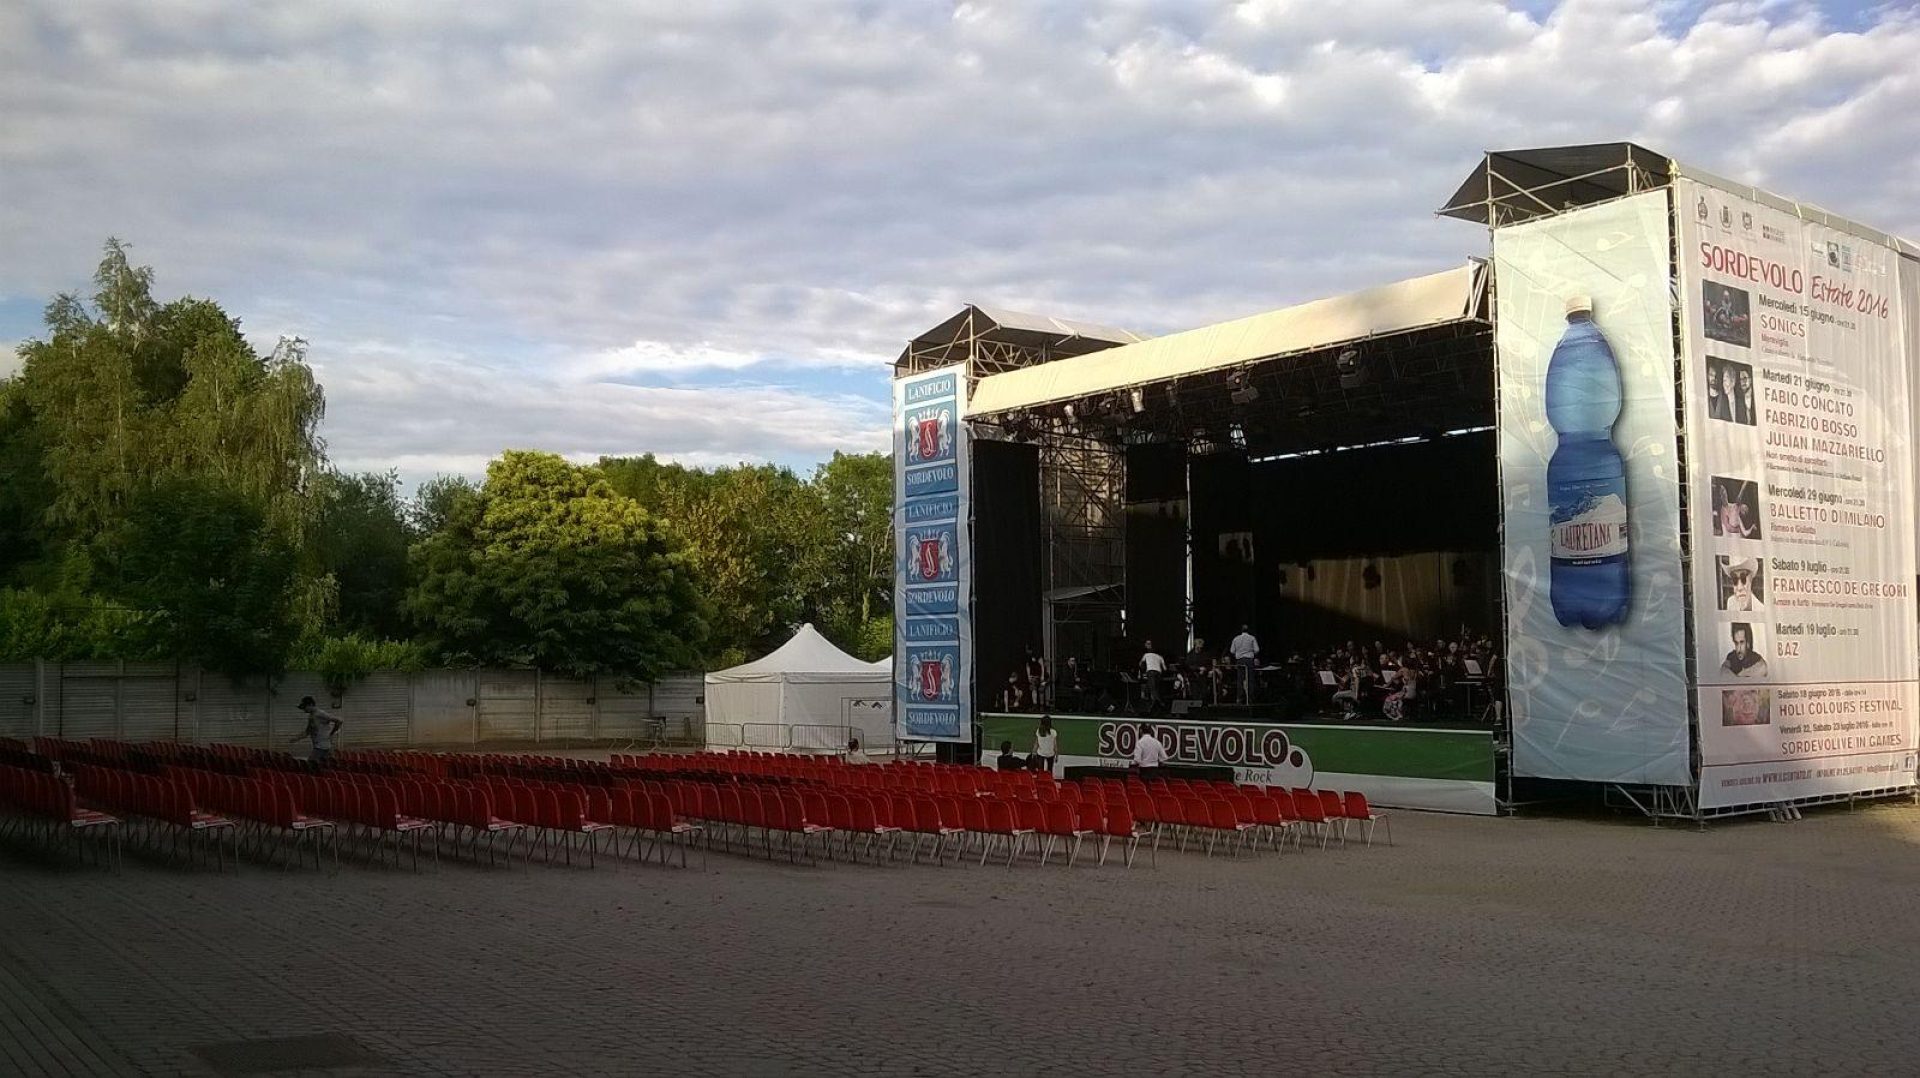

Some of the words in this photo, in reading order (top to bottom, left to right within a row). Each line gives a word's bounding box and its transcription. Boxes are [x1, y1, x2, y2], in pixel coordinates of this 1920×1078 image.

[1700, 242, 1803, 294] SORDEVOLO
[1812, 275, 1854, 308] Estate
[1857, 289, 1888, 319] 2016
[1800, 305, 1809, 317] 15
[1811, 309, 1834, 325] giugno
[1760, 314, 1805, 337] SONICS
[908, 379, 951, 400] LANIFICIO
[1793, 374, 1802, 388] 21
[1805, 378, 1830, 393] giugno
[1765, 387, 1798, 406] FABIO
[1802, 394, 1853, 417] CONCATO
[1766, 409, 1819, 431] FABRIZIO
[1822, 419, 1857, 438] BOSSO
[1766, 431, 1808, 450] JULIAN
[1812, 438, 1884, 462] MAZZARIELLO
[907, 466, 954, 486] SORDEVOLO
[1807, 489, 1817, 501] 29
[1818, 492, 1842, 505] giugno
[909, 501, 953, 518] LANIFICIO
[1770, 503, 1827, 522] BALLETTO
[1832, 509, 1841, 523] DI
[1844, 511, 1885, 529] MILANO
[1560, 522, 1612, 551] LAURETANA
[1772, 557, 1799, 571] Sabato
[1800, 560, 1805, 571] 9
[1807, 560, 1827, 575] luglio
[1773, 578, 1841, 595] FRANCESCO
[1845, 581, 1858, 595] DE
[906, 590, 955, 604] SORDEVOLO
[910, 623, 953, 637] LANIFICIO
[1807, 623, 1815, 635] 19
[1816, 623, 1837, 638] luglio
[1777, 641, 1800, 657] BAZ
[1778, 689, 1799, 699] Sabato
[1808, 689, 1827, 700] giugno
[1779, 704, 1805, 716] HOLI
[1808, 701, 1856, 715] COLOURS
[1859, 700, 1903, 713] FESTIVAL
[908, 711, 956, 725] SORDEVOLO
[1812, 723, 1831, 732] Sabato
[1099, 722, 1291, 765] SODEVOLO
[1782, 736, 1853, 755] SORDEVOLIVE
[1856, 736, 1866, 748] IN
[1869, 734, 1902, 747] GAMES
[1245, 769, 1272, 784] Rock
